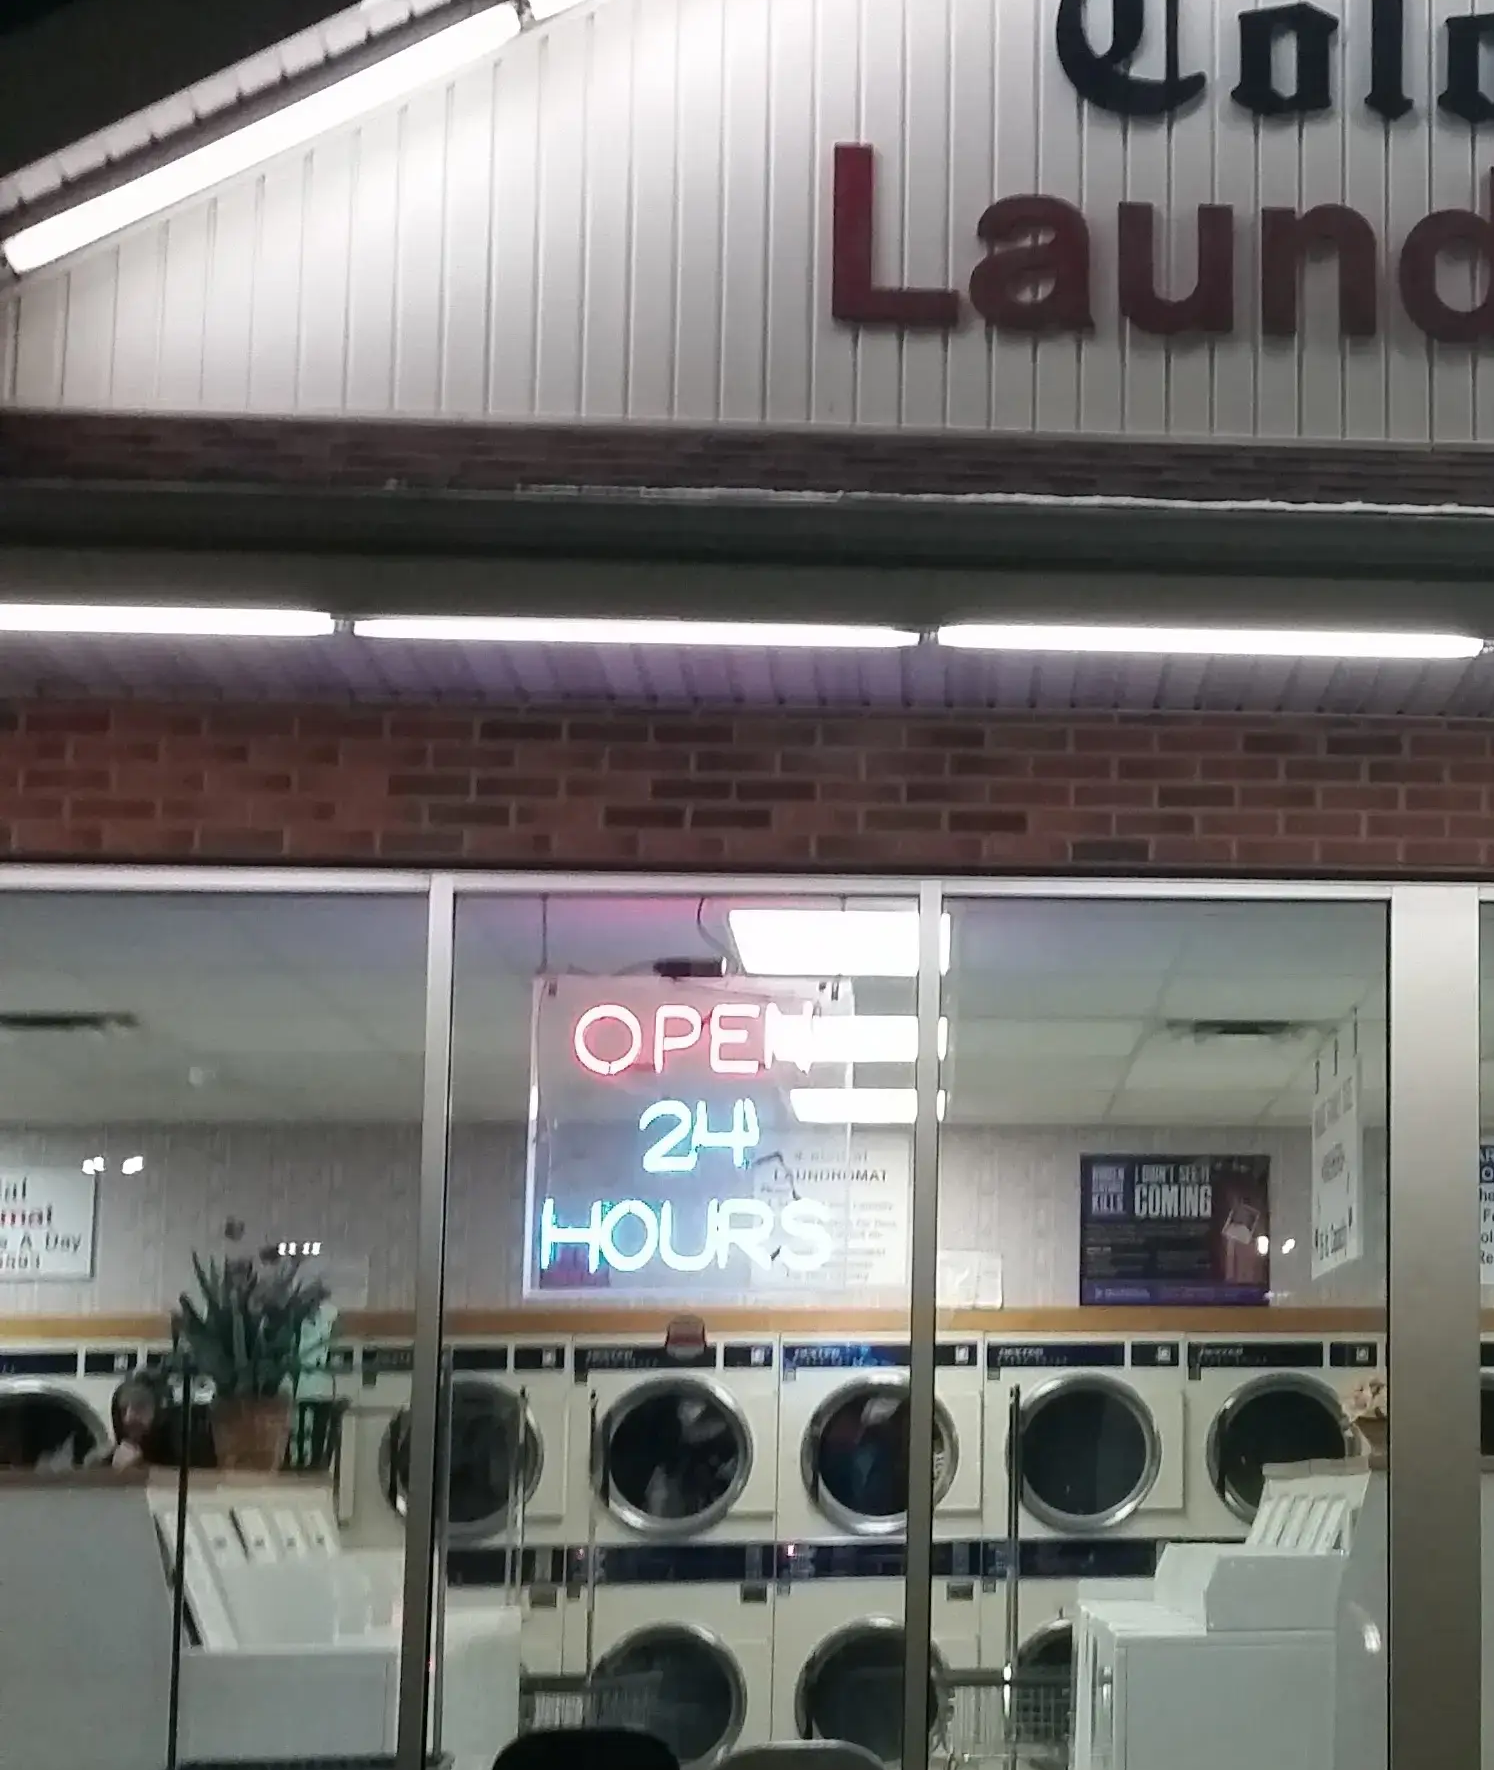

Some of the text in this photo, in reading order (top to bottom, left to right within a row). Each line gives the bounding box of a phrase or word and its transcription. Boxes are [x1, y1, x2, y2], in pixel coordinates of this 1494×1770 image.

[574, 1003, 814, 1075] OPEN
[638, 1098, 760, 1173] 24
[539, 1197, 835, 1274] HOURS
[1134, 1183, 1213, 1218] COMING
